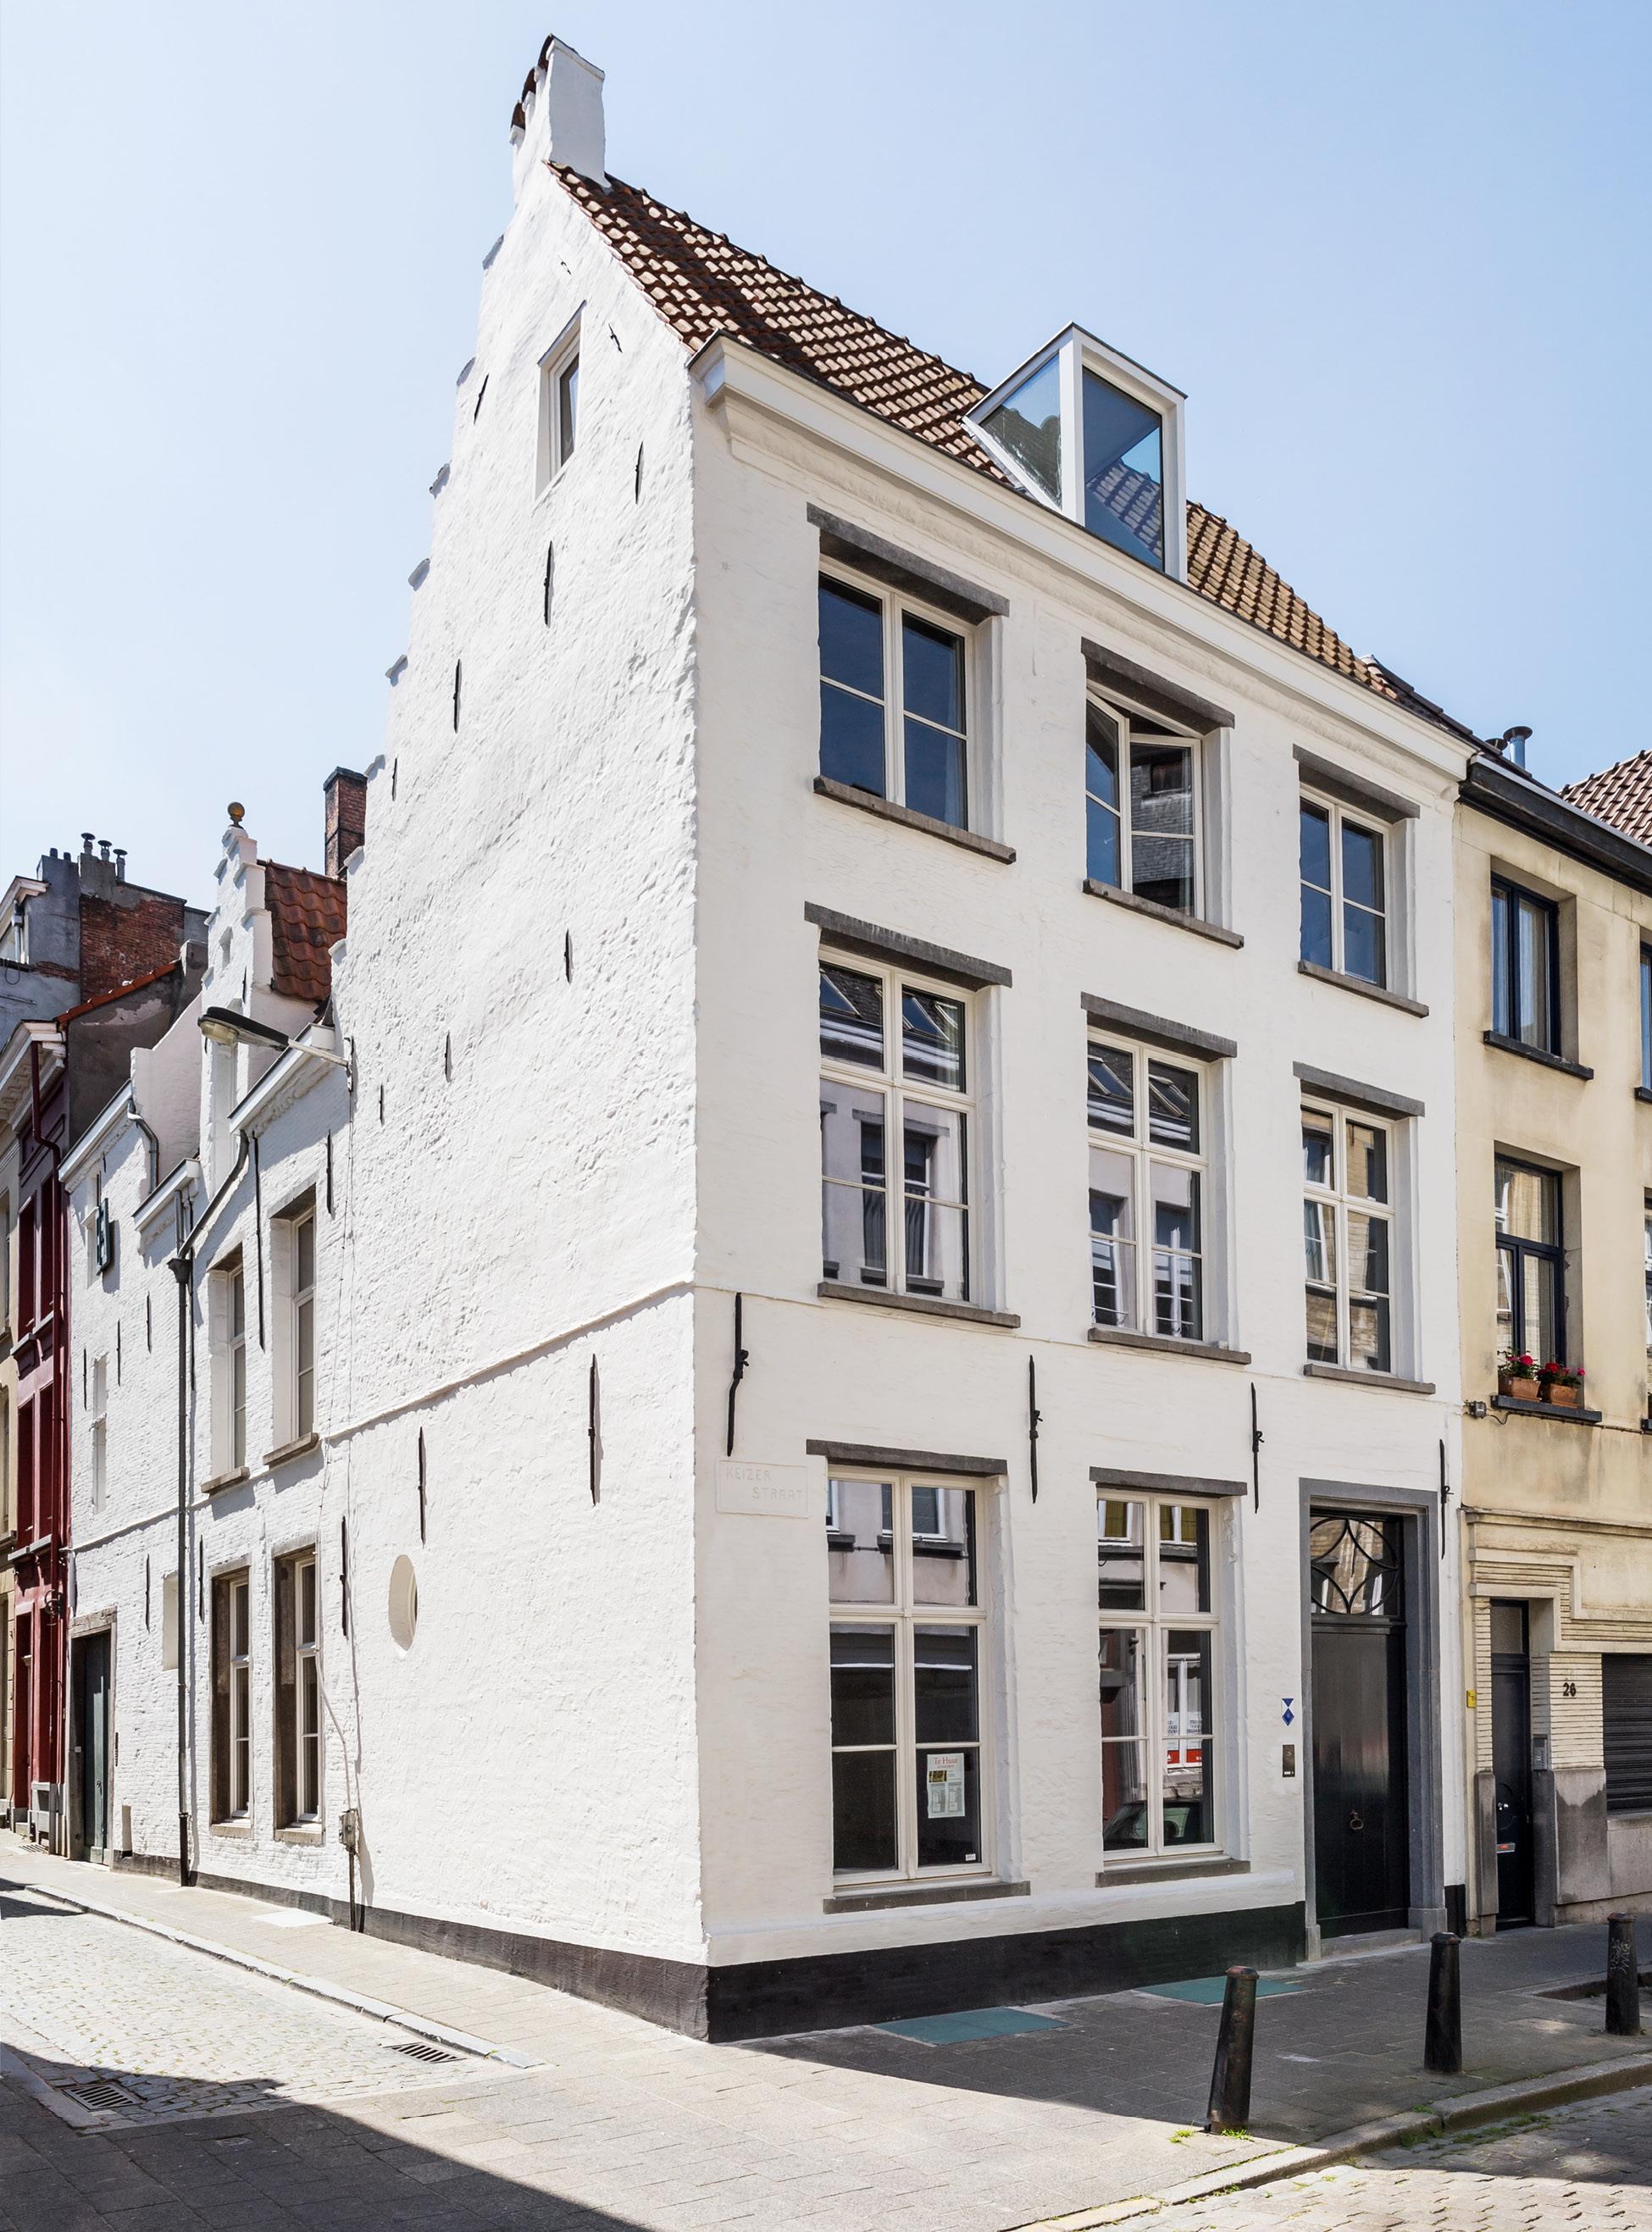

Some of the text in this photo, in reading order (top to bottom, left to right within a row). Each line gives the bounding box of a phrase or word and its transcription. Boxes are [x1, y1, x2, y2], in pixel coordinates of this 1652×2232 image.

[726, 1466, 772, 1482] KEIZER
[751, 1487, 802, 1501] STRAAT
[1562, 1681, 1577, 1698] 26
[942, 1756, 958, 1764] Huur
